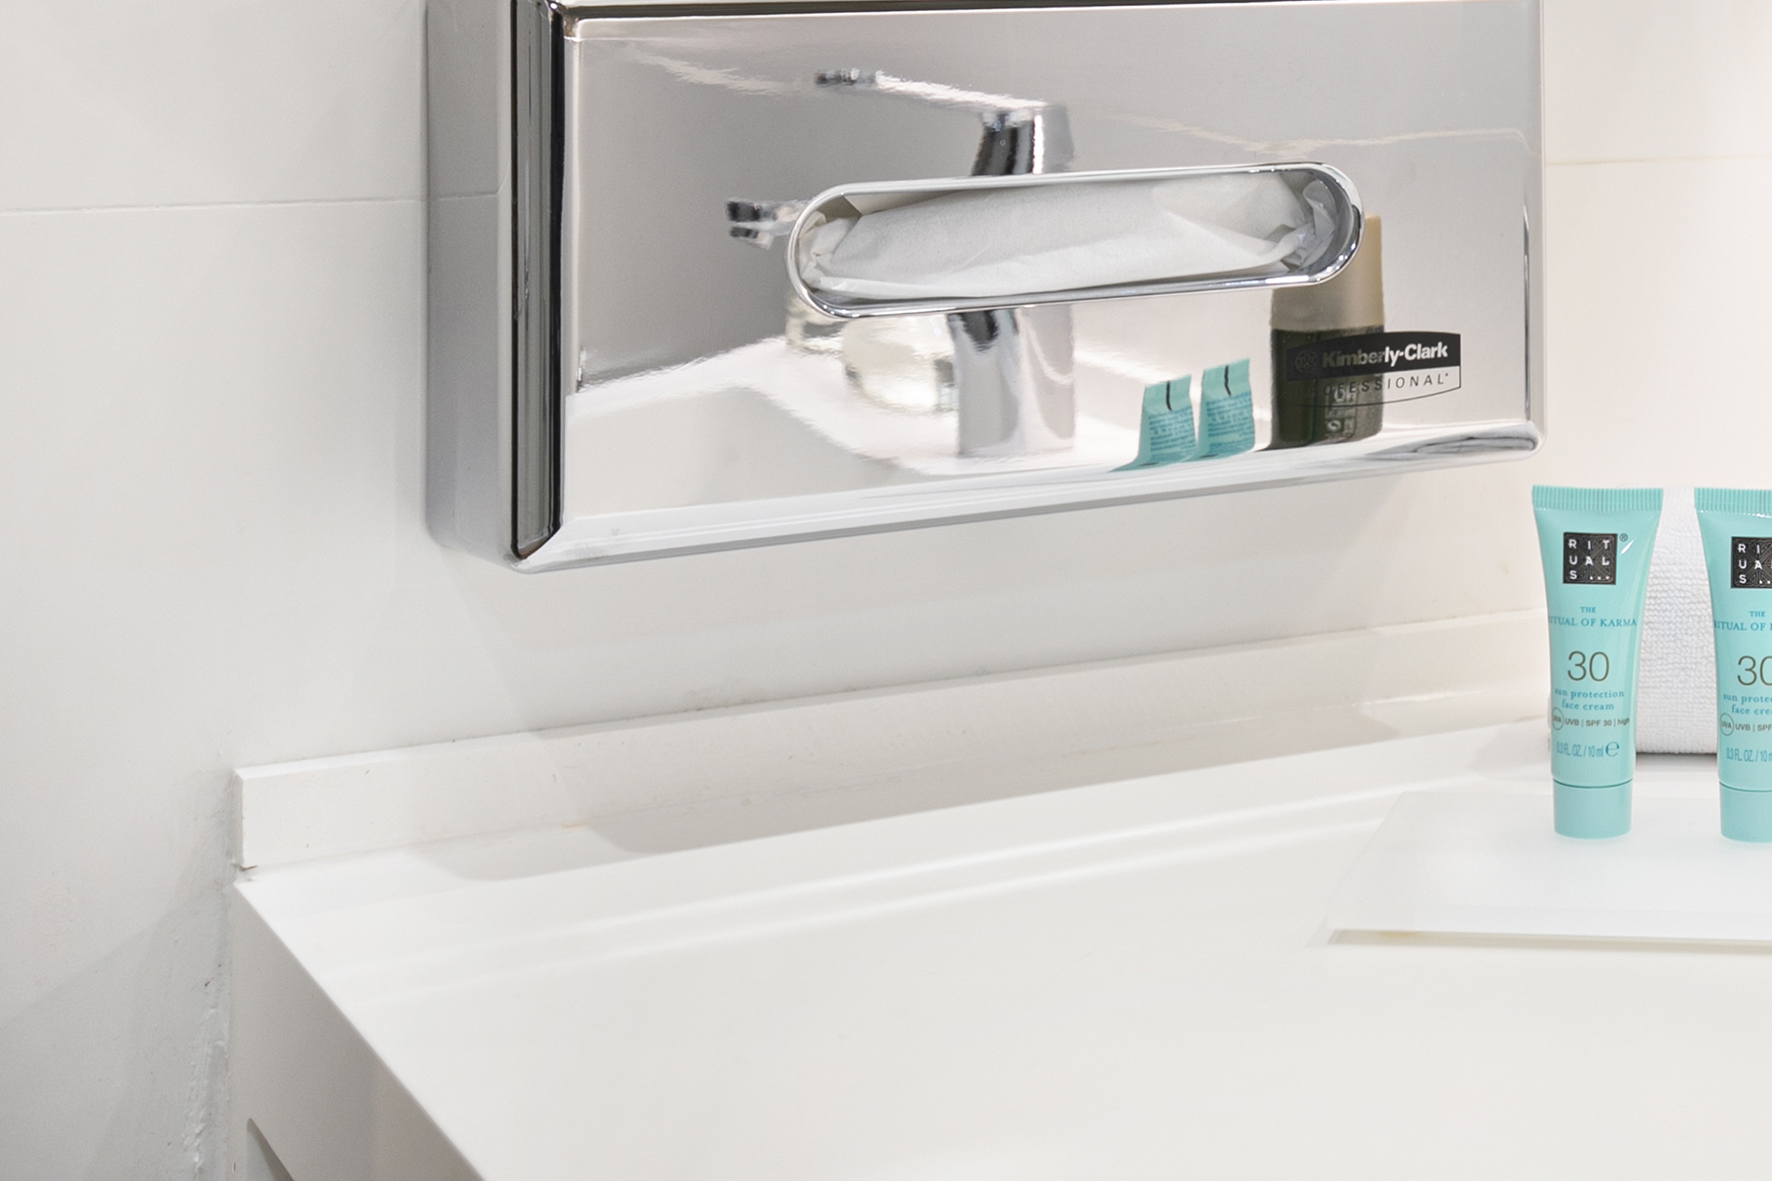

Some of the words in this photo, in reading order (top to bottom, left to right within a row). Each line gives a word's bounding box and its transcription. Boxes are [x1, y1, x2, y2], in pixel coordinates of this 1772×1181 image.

[1580, 606, 1597, 614] THE
[1580, 618, 1597, 627] OF
[1600, 618, 1637, 627] KARMA
[1750, 622, 1767, 631] OF
[1567, 650, 1610, 682] 30
[1570, 690, 1625, 700] protection
[1562, 699, 1580, 710] face
[1582, 703, 1614, 711] cream
[1731, 704, 1750, 715] face
[1564, 717, 1580, 726] UVB
[1585, 719, 1601, 727] SPF
[1603, 719, 1613, 727] 30
[1735, 723, 1751, 731] UVB
[1757, 724, 1772, 732] SPF
